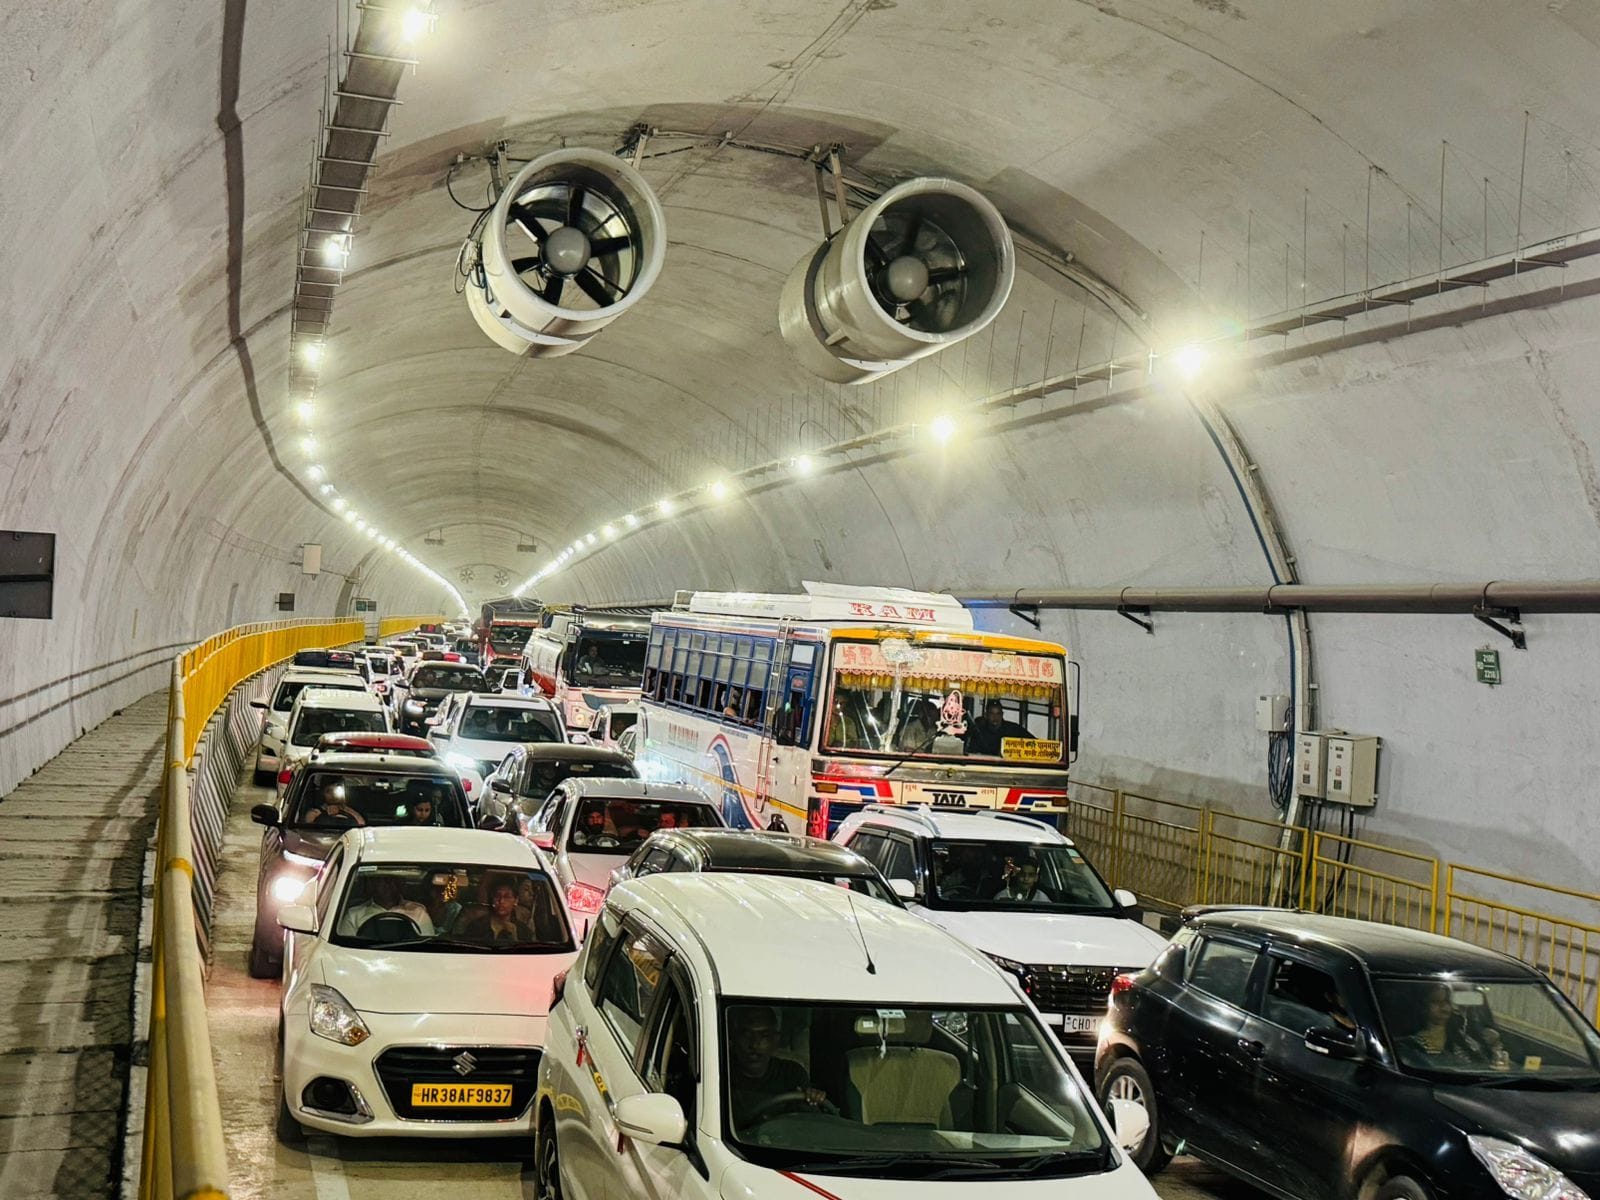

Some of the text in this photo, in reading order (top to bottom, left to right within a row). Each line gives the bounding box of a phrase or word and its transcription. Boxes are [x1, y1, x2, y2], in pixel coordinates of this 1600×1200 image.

[848, 602, 937, 622] RAM
[932, 793, 967, 807] TATA
[421, 1088, 511, 1103] HR38AF9837
